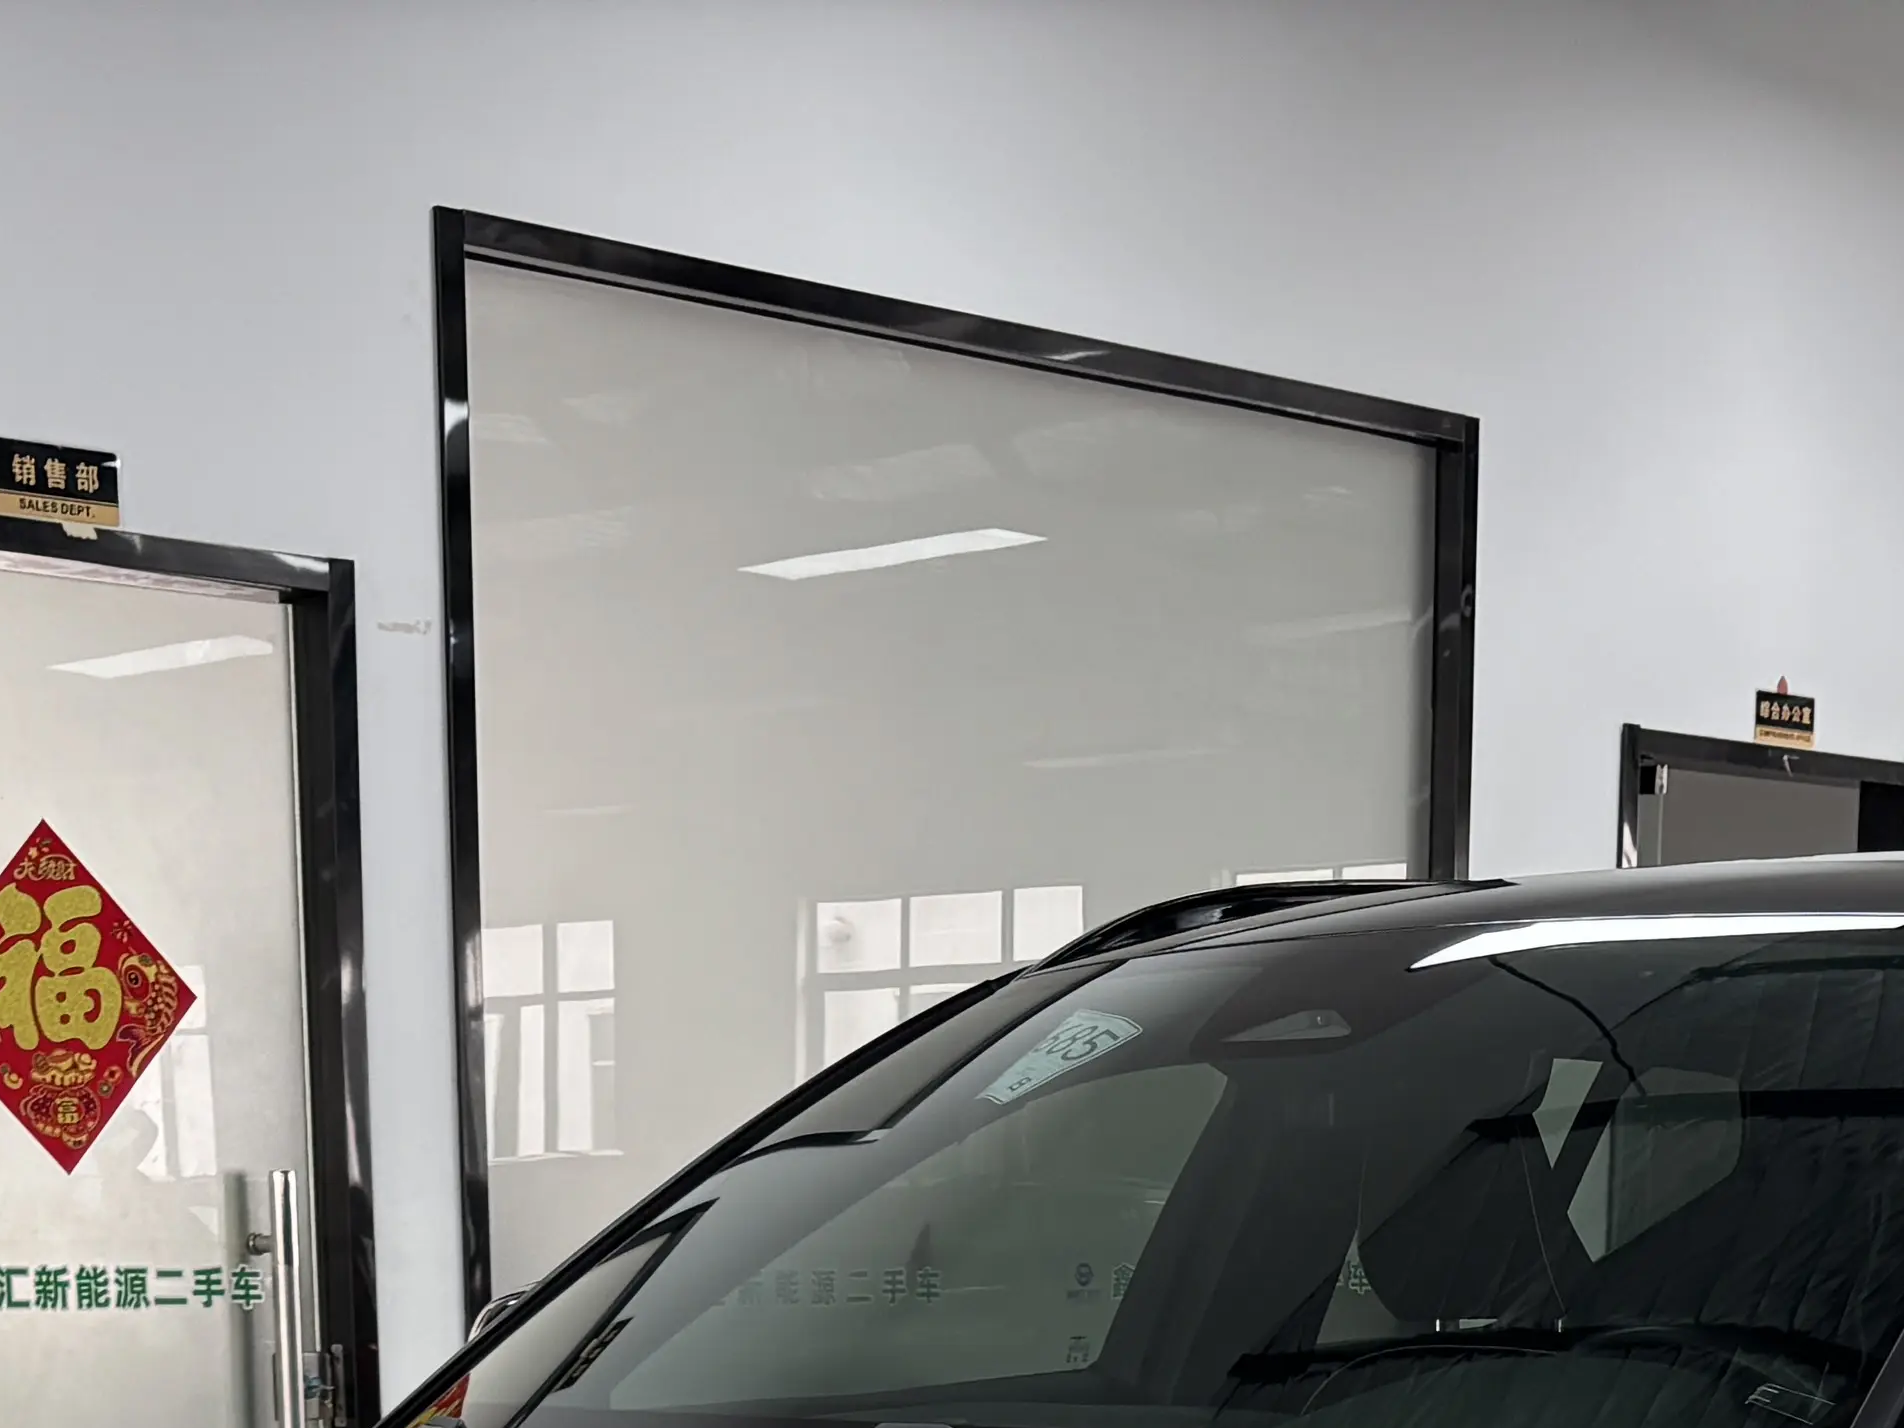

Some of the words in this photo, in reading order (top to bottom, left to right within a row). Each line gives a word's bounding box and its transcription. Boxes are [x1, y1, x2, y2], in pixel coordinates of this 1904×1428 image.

[12, 453, 100, 493] 销售部
[18, 498, 58, 514] SALES
[61, 503, 96, 518] DEPT.
